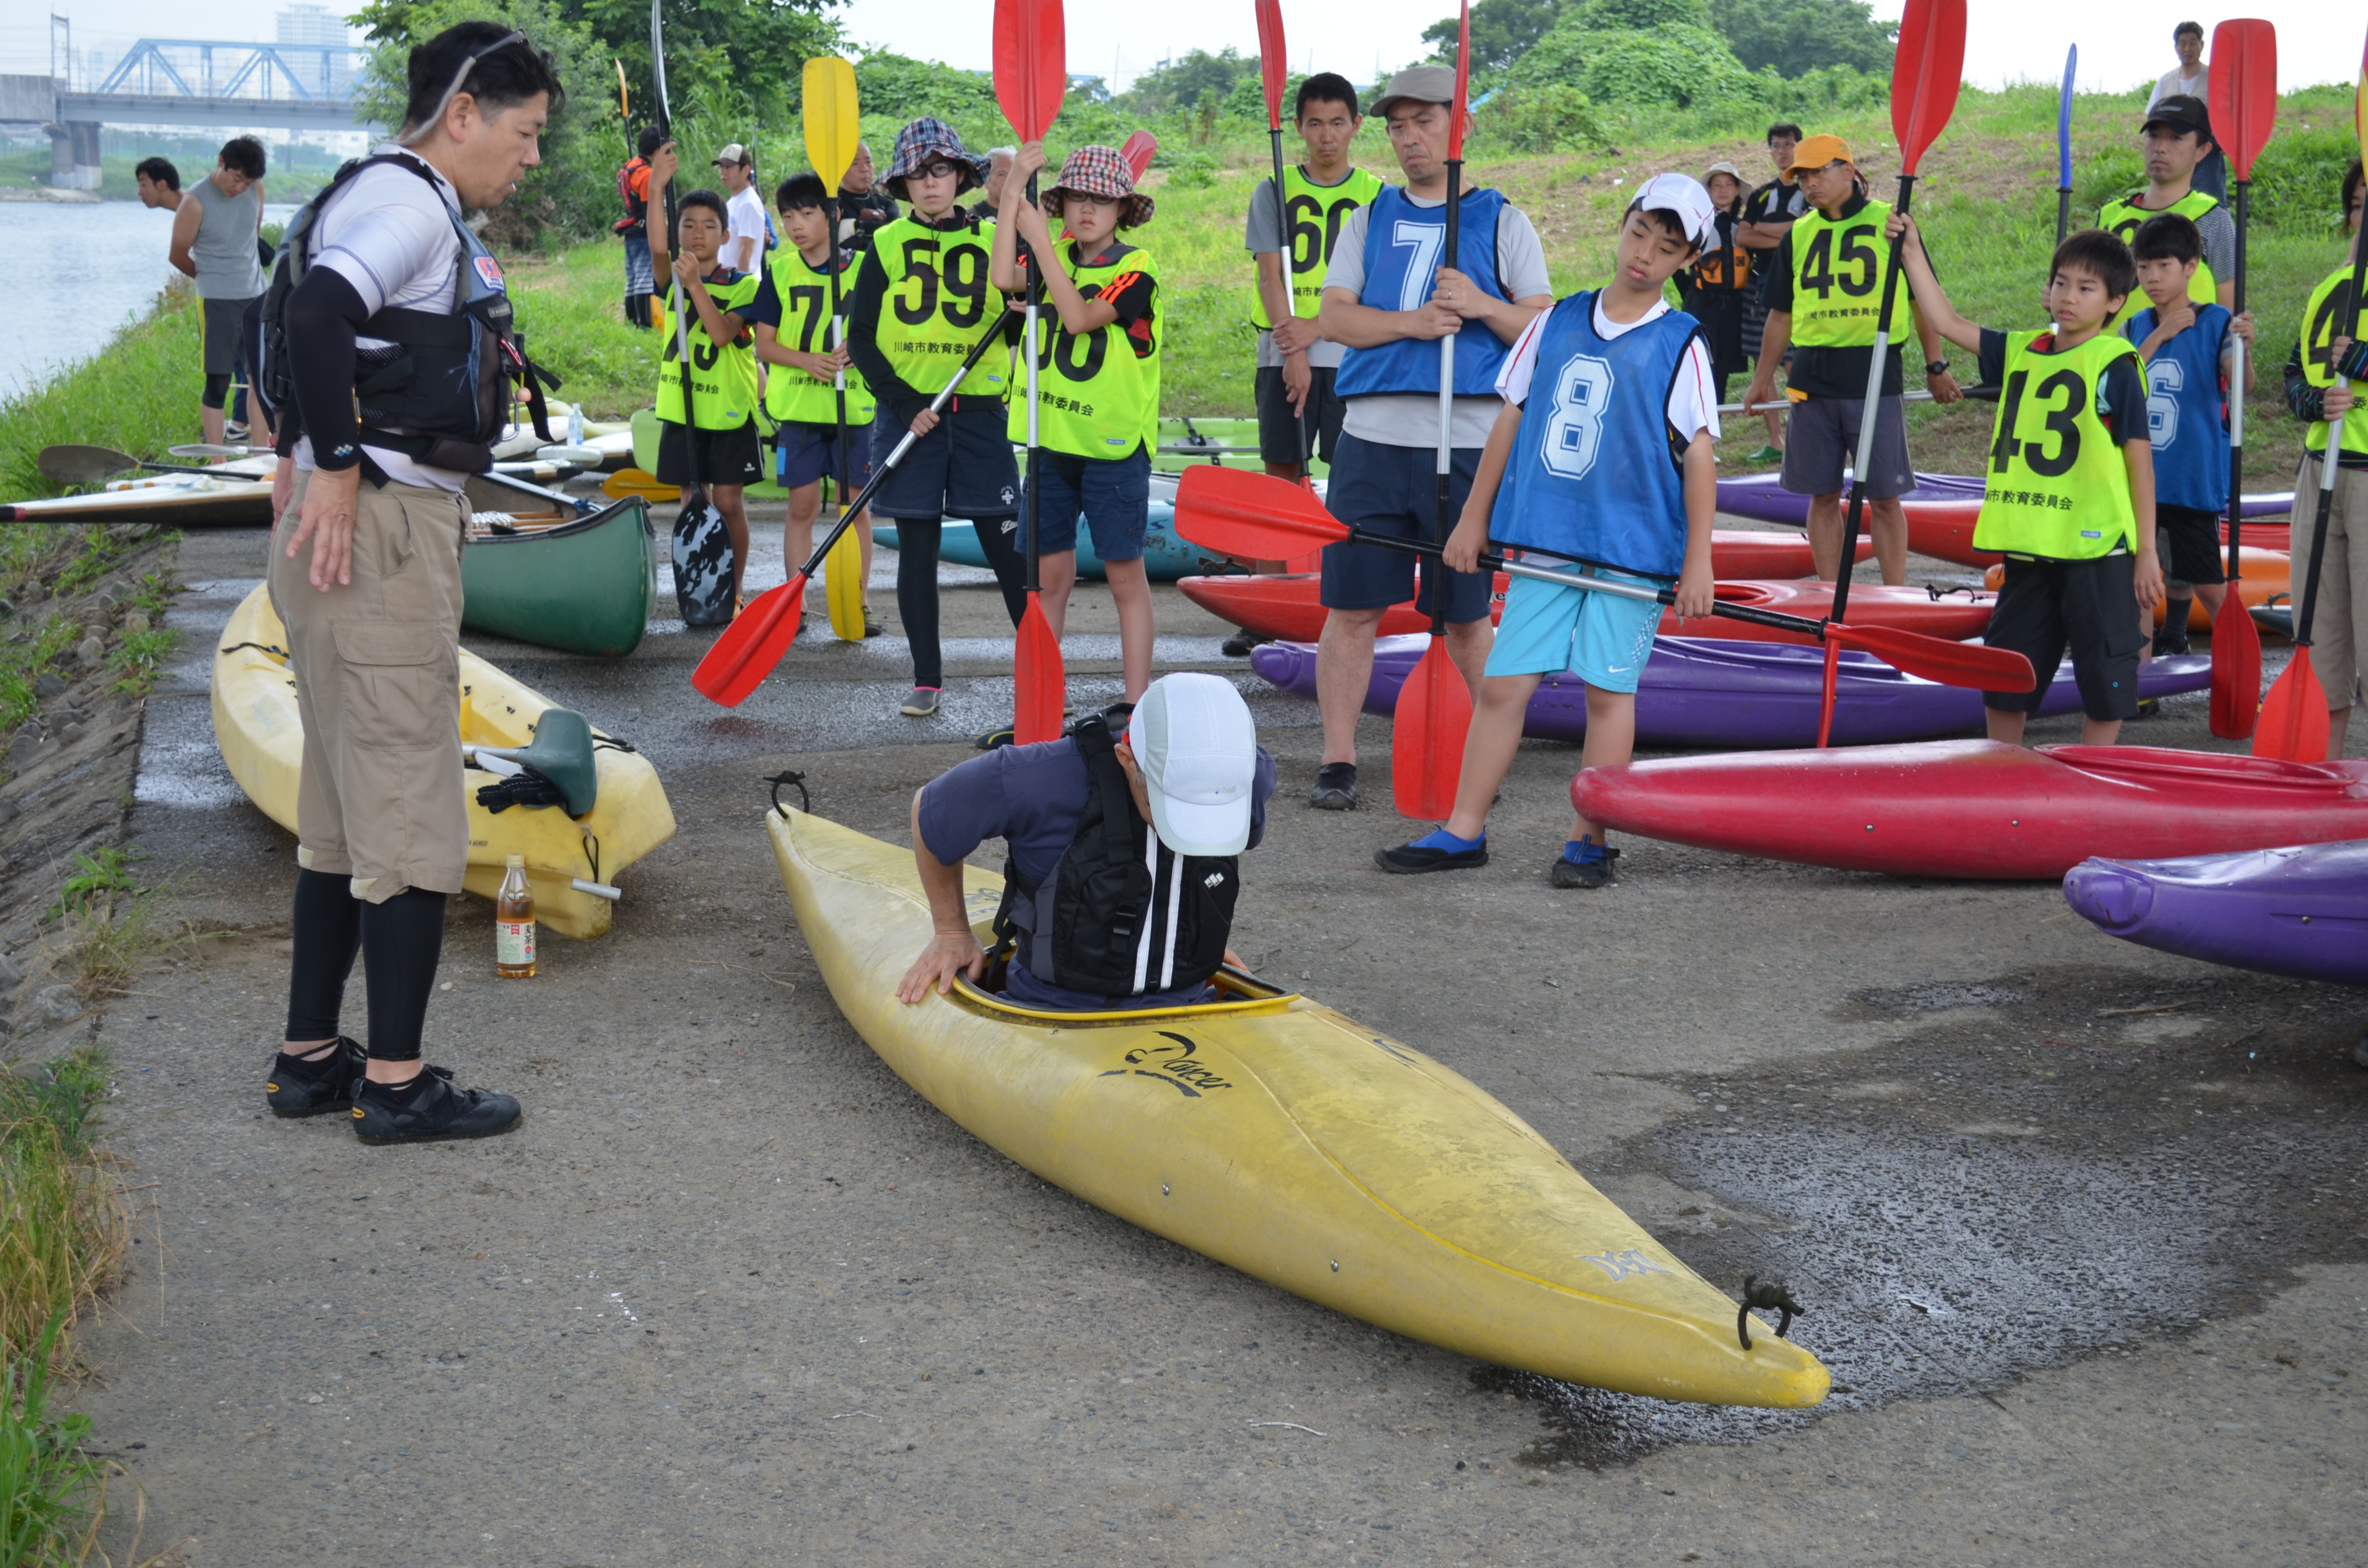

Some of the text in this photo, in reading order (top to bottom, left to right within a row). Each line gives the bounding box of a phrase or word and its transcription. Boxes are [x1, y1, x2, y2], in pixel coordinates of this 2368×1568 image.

[894, 238, 989, 329] 59
[1392, 220, 1446, 312] 7
[1800, 224, 1877, 300] 45
[894, 341, 985, 356] 川崎市教育委員
[1540, 353, 1615, 481] 8
[1990, 368, 2087, 478] 43
[2145, 357, 2184, 451] 6
[1985, 488, 2073, 511] 市教育委員会
